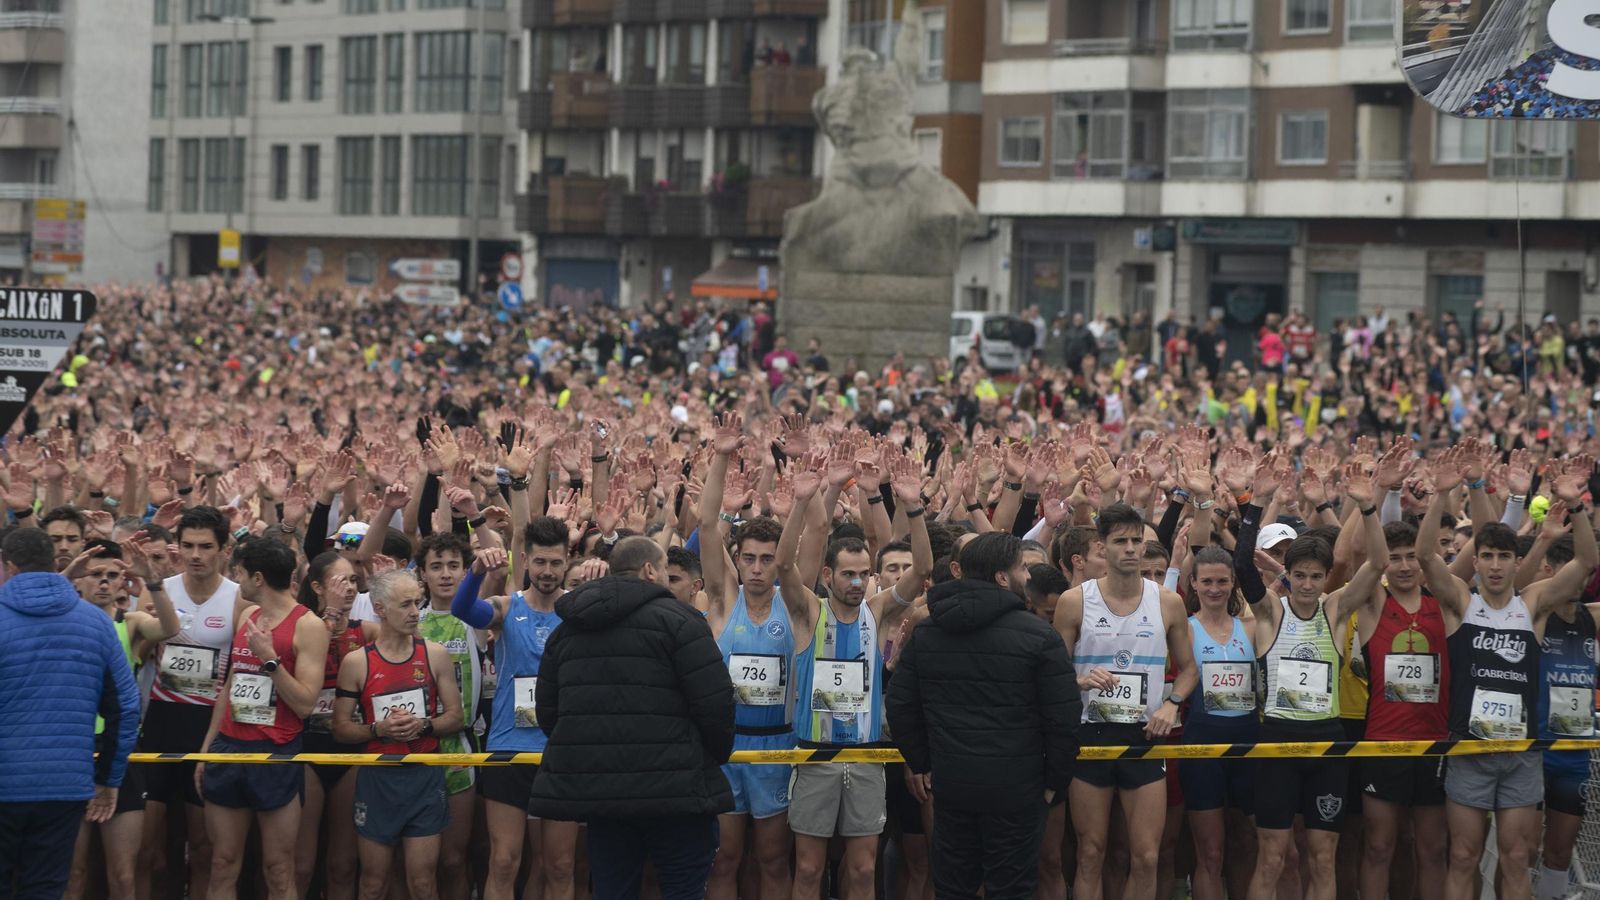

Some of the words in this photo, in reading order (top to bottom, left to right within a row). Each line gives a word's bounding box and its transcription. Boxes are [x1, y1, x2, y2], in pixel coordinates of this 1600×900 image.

[72, 293, 82, 320] 1
[0, 327, 66, 339] BSOLUTA
[0, 348, 24, 357] SUB
[28, 349, 41, 357] 18
[169, 656, 201, 672] 2891
[742, 666, 767, 681] 736
[834, 672, 842, 686] 5
[1299, 672, 1308, 686] 2
[1397, 665, 1422, 679] 728
[1547, 670, 1594, 684] NARÓN
[1212, 673, 1244, 687] 2457
[234, 683, 261, 700] 2876
[1482, 701, 1513, 718] 9751
[1570, 698, 1578, 711] 3
